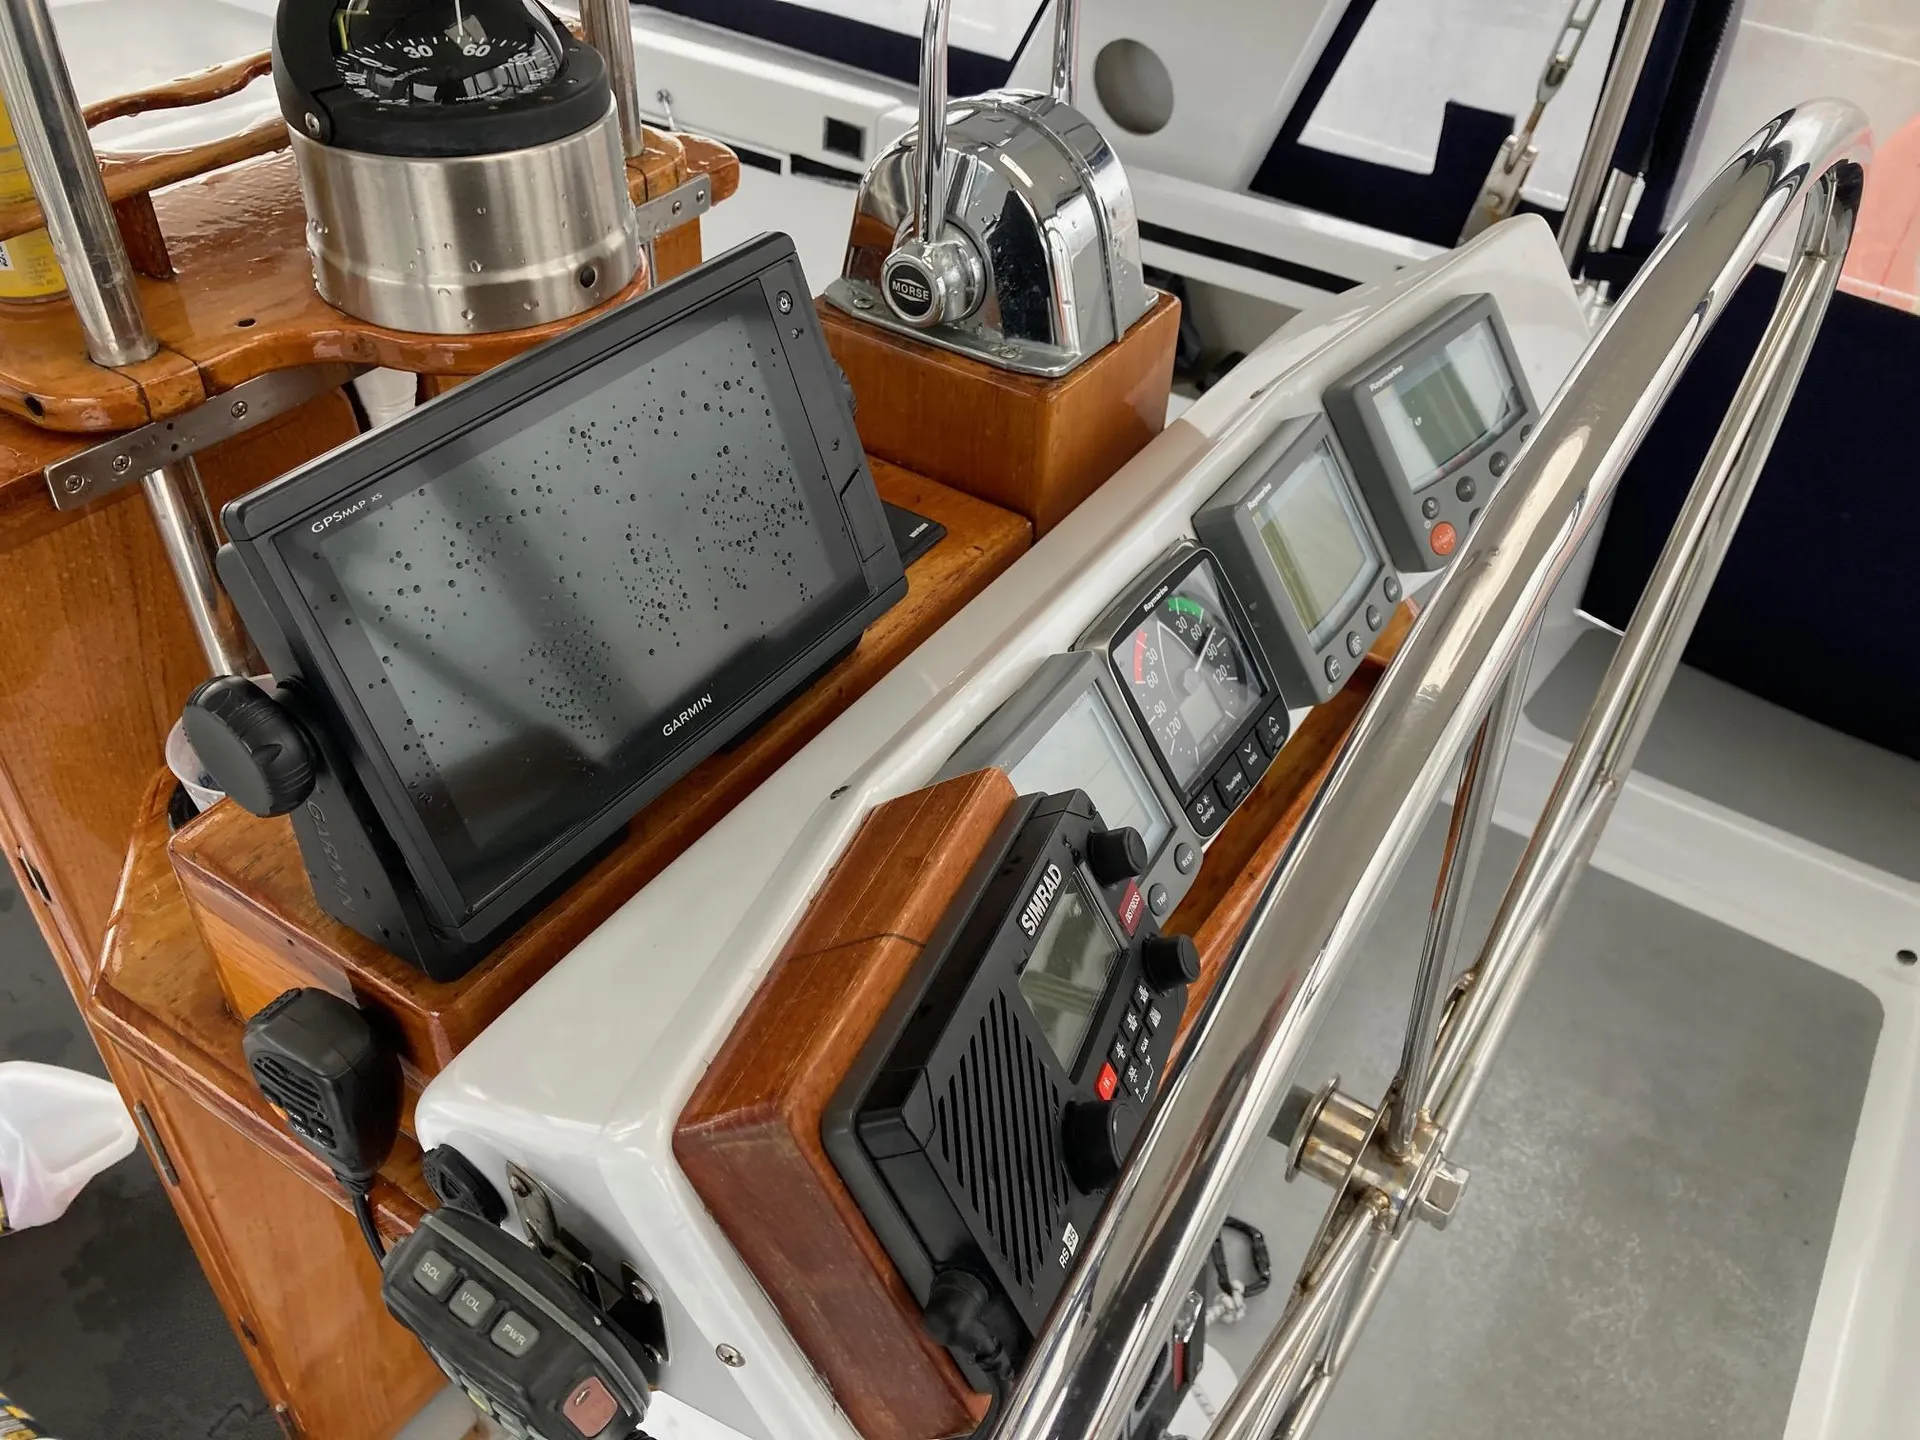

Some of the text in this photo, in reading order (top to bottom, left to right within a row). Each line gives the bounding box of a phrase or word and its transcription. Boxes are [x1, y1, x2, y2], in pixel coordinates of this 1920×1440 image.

[403, 45, 433, 59] 30
[463, 44, 491, 57] 60
[892, 280, 930, 300] MORSE
[311, 500, 366, 533] GPSMAP
[1143, 585, 1169, 612] Raymarine
[1175, 616, 1188, 633] 30
[1190, 624, 1202, 641] 60
[1146, 648, 1158, 665] 30
[1206, 643, 1218, 660] 90
[1146, 671, 1159, 688] 60
[1213, 664, 1228, 685] 120
[662, 693, 712, 736] GARMIN
[1154, 700, 1167, 718] 90
[1166, 717, 1181, 738] 120
[1020, 864, 1062, 938] SIMRAD
[1059, 1228, 1077, 1269] RS 35
[421, 1262, 441, 1281] SQL
[460, 1291, 480, 1313] VOL
[502, 1323, 527, 1347] PWR
